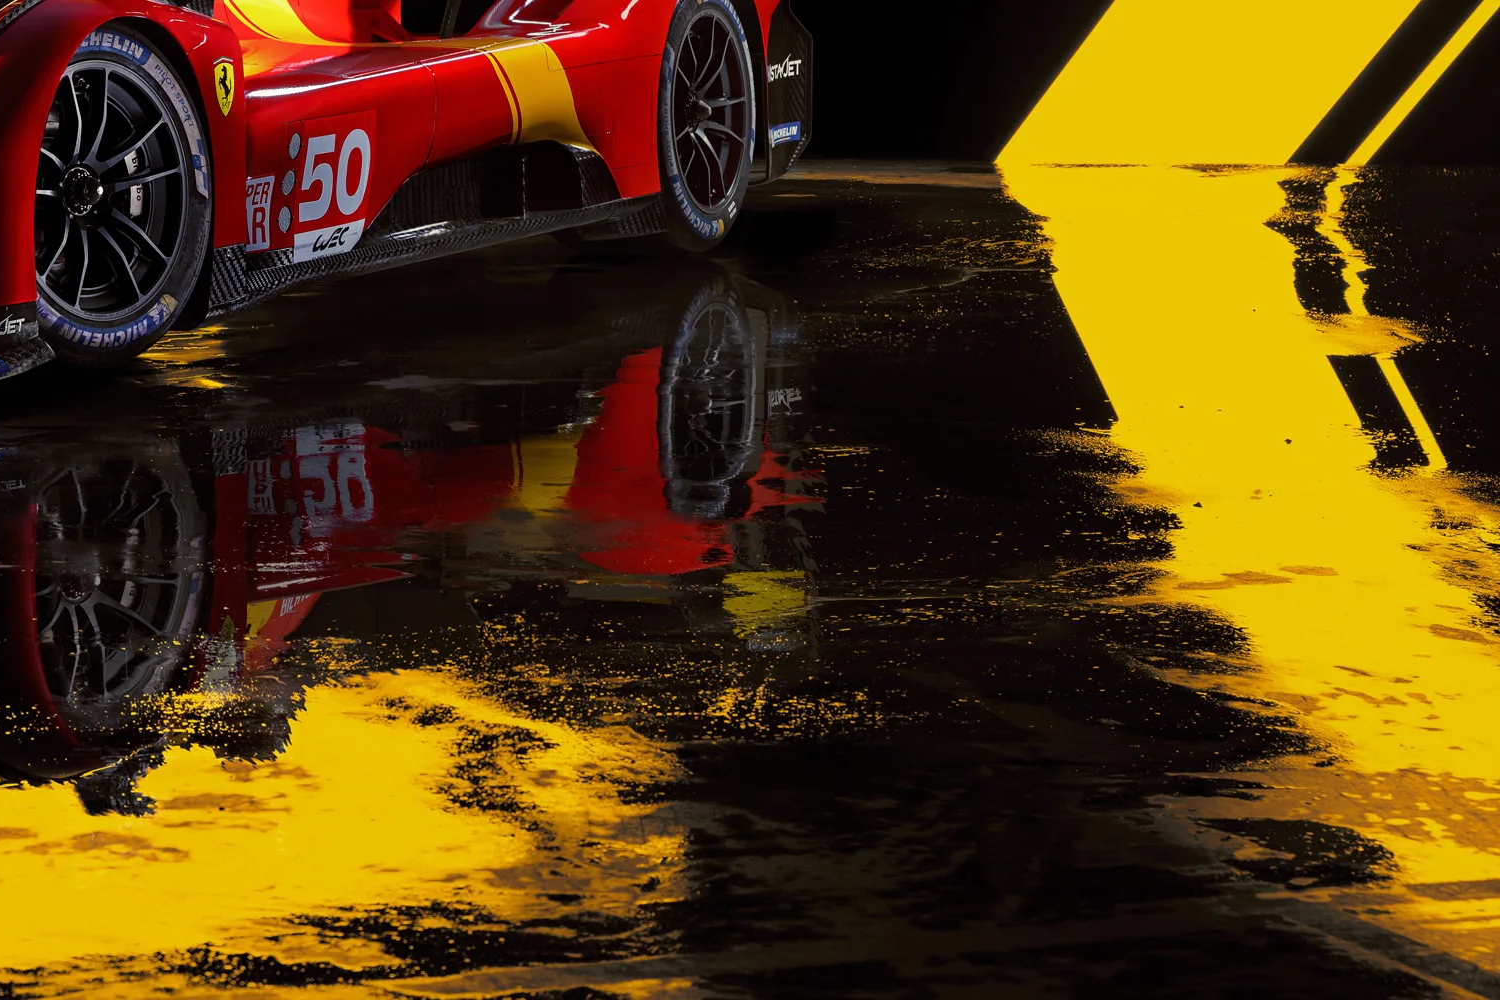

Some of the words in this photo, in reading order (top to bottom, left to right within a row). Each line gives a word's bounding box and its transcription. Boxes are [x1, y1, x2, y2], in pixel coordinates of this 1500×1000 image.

[79, 31, 144, 59] CHELIN
[154, 63, 176, 90] PILOT
[175, 92, 195, 128] SPORT
[298, 128, 371, 223] 50
[246, 181, 270, 206] PER
[673, 181, 711, 237] MICHELIN
[312, 226, 350, 253] WEC
[58, 318, 148, 349] MICHELIN
